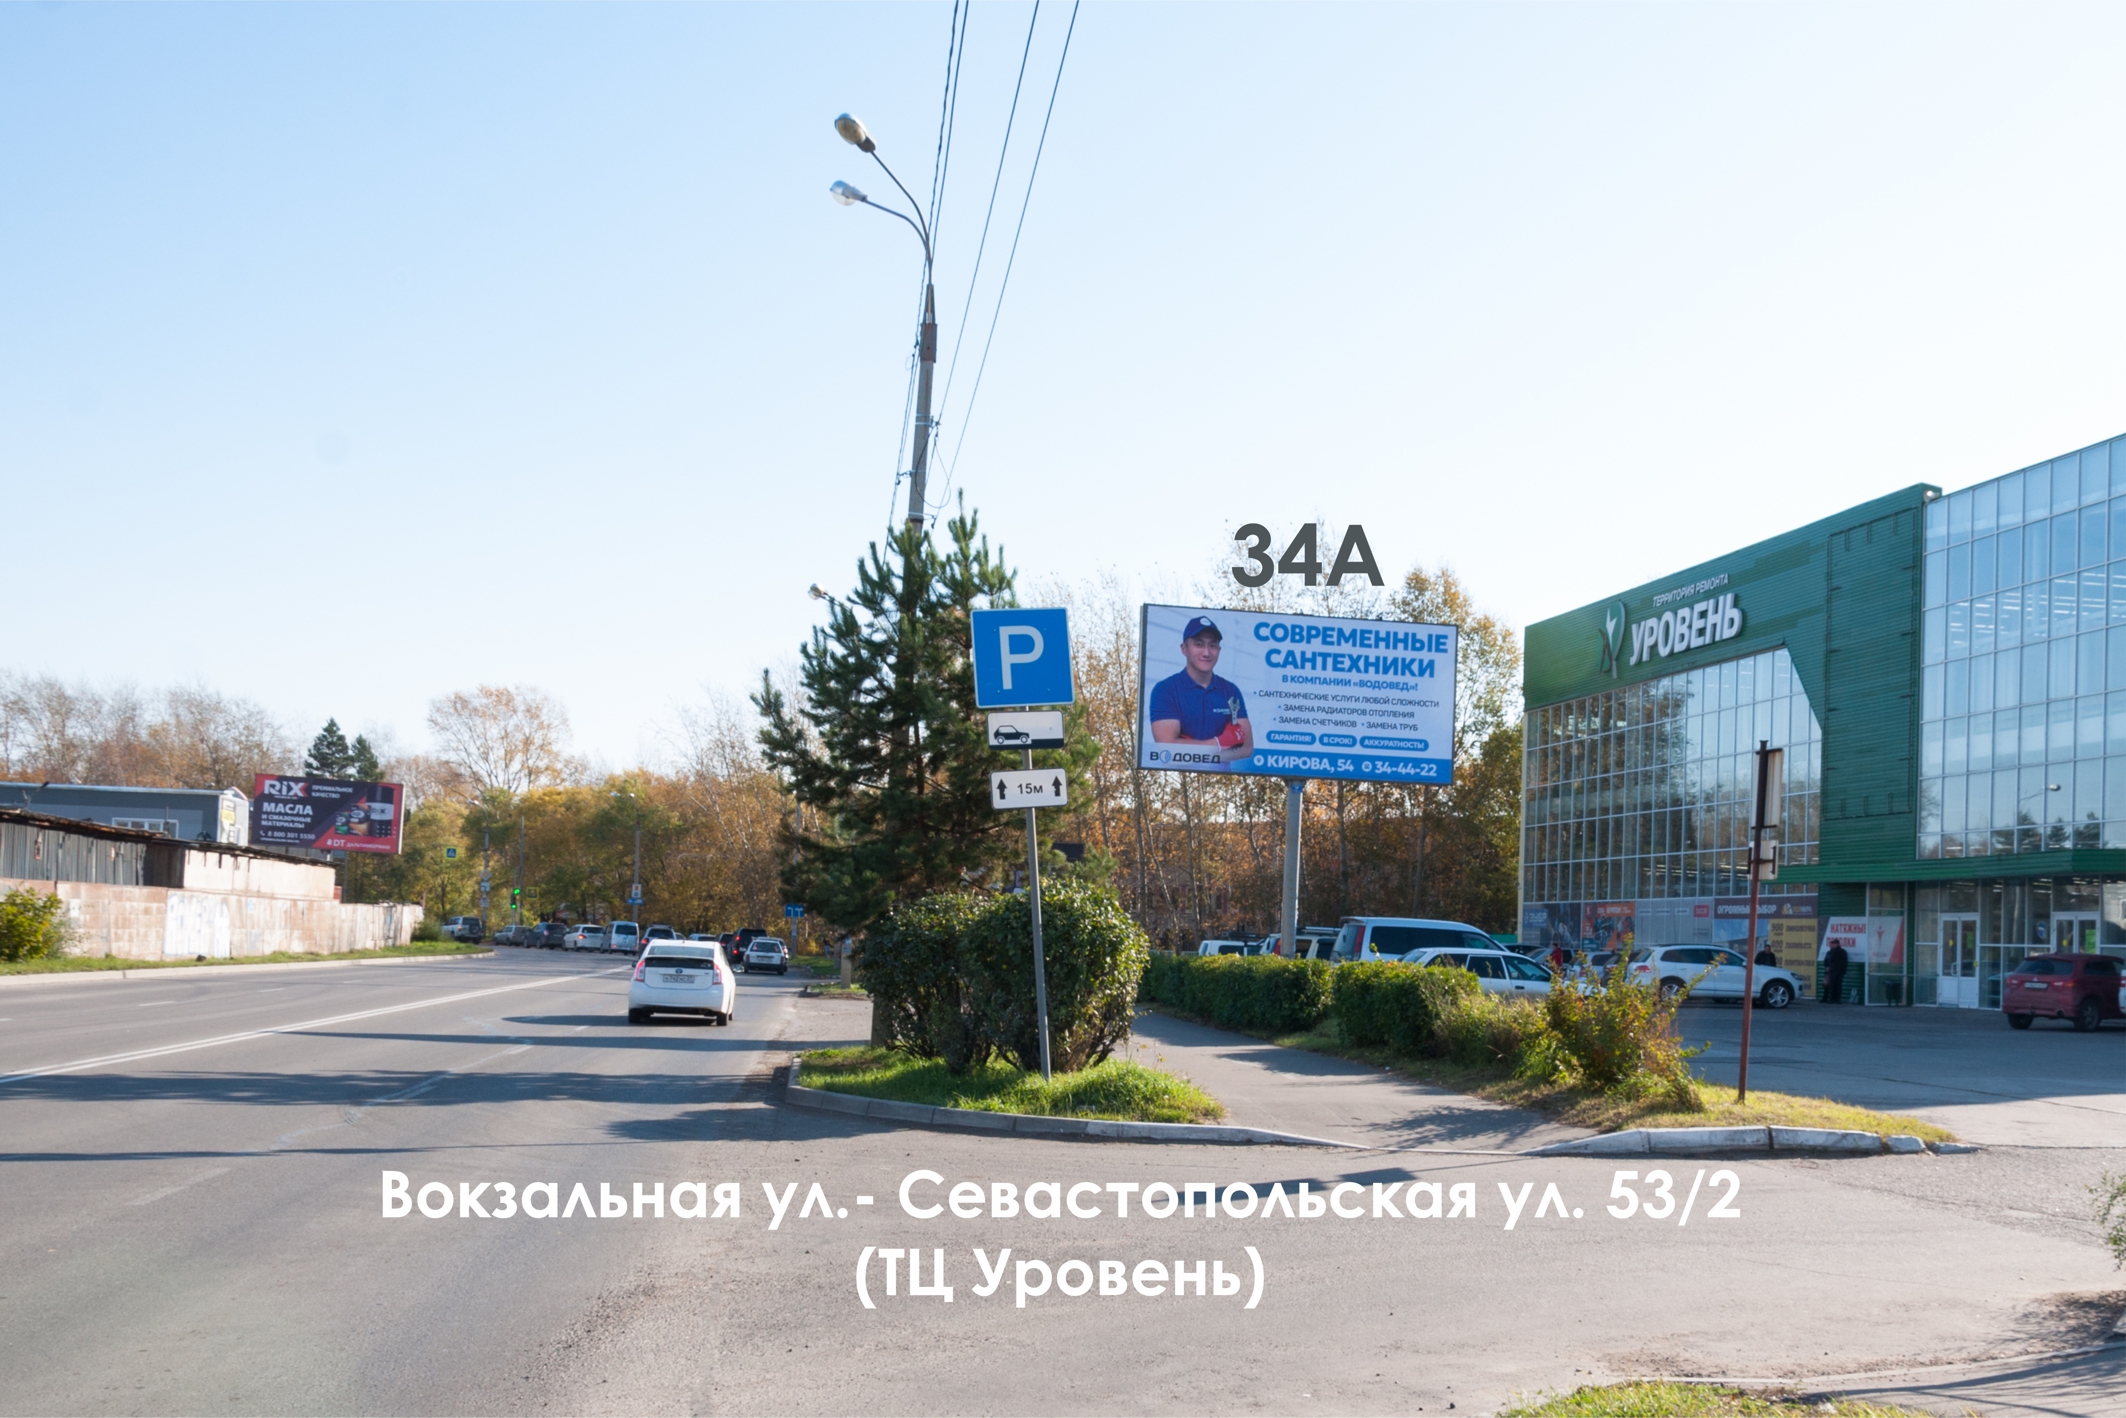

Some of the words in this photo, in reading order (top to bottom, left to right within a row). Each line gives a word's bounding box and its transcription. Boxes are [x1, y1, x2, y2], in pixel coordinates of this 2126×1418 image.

[1653, 584, 1695, 608] ТЕРРИТОРИЯ
[1695, 572, 1729, 593] РЕМОНТА
[1629, 592, 1743, 666] УРОВЕНЬ
[1253, 621, 1448, 654] СОВРЕМЕННЫЕ
[999, 625, 1044, 690] P
[1265, 648, 1435, 678] САНТЕХНИКИ
[1282, 675, 1288, 683] В
[1290, 675, 1351, 687] КОМПАНИИ
[1353, 679, 1418, 692] «ВОДОВЕД»!
[1258, 689, 1329, 701] САНТЕХНИЧЕСКИЕ
[1331, 694, 1360, 703] УСЛУГИ
[1361, 695, 1390, 705] ЛЮБОЙ
[1391, 698, 1439, 708] СЛОЖНОСТИ
[1283, 704, 1316, 713] ЗАМЕНА
[1316, 706, 1368, 716] РАДИАТОРОВ
[1368, 709, 1415, 718] ОТОПЛЕНИЯ
[1279, 716, 1310, 725] ЗАМЕНА
[1312, 718, 1357, 728] СЧЕТЧИКОВ
[1366, 721, 1397, 730] ЗАМЕНА
[1399, 723, 1418, 731] ТРУБ
[1271, 733, 1311, 742] ГАРАНТИЯ!
[1329, 736, 1352, 745] СРОК!
[1364, 738, 1424, 749] АККУРАТНОСТЬ!
[1267, 755, 1335, 773] КИРОВА,
[1337, 759, 1354, 772] 54
[1375, 761, 1437, 776] 34-44-22
[262, 802, 313, 815] МАСЛА
[261, 820, 304, 828] МАТЕРИАЛЫ
[268, 814, 311, 823] СМАЗОЧНЫЕ
[1830, 923, 1866, 934] НАТЯЖНЫЕ
